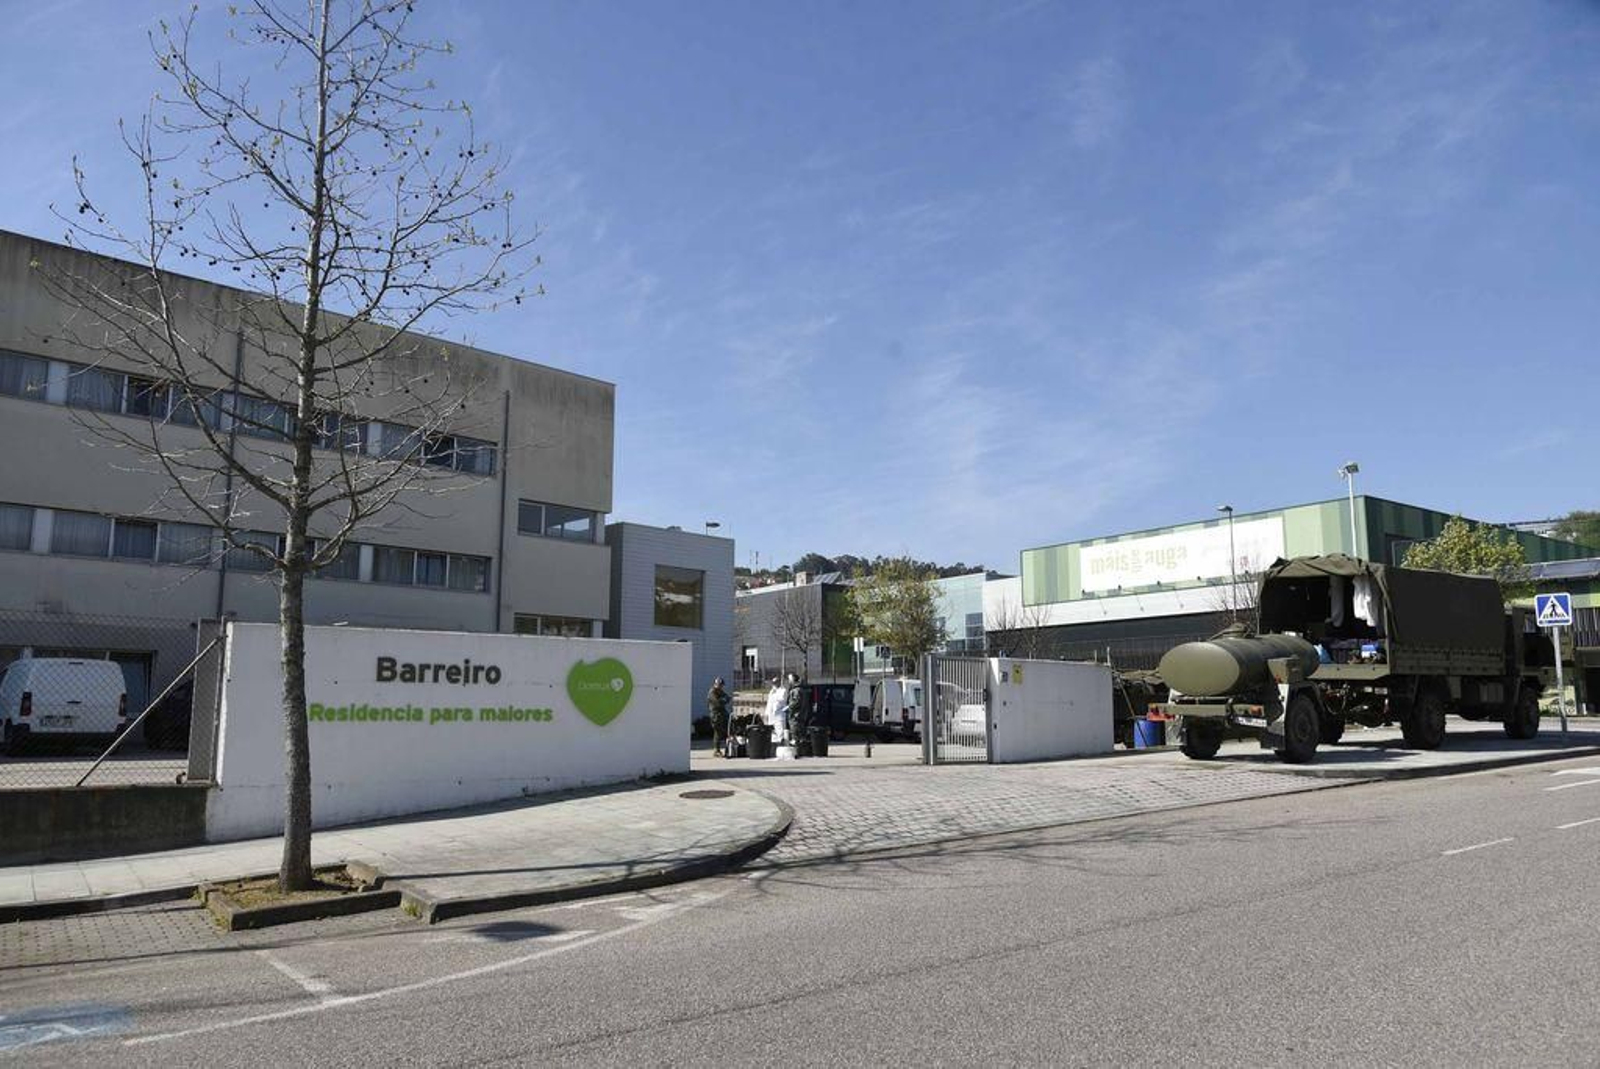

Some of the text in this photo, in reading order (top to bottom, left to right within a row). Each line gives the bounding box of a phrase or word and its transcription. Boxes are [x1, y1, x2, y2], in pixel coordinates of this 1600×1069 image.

[1144, 546, 1188, 570] auga
[376, 656, 502, 685] Barreiro
[309, 703, 553, 724] Residencia para maiores
